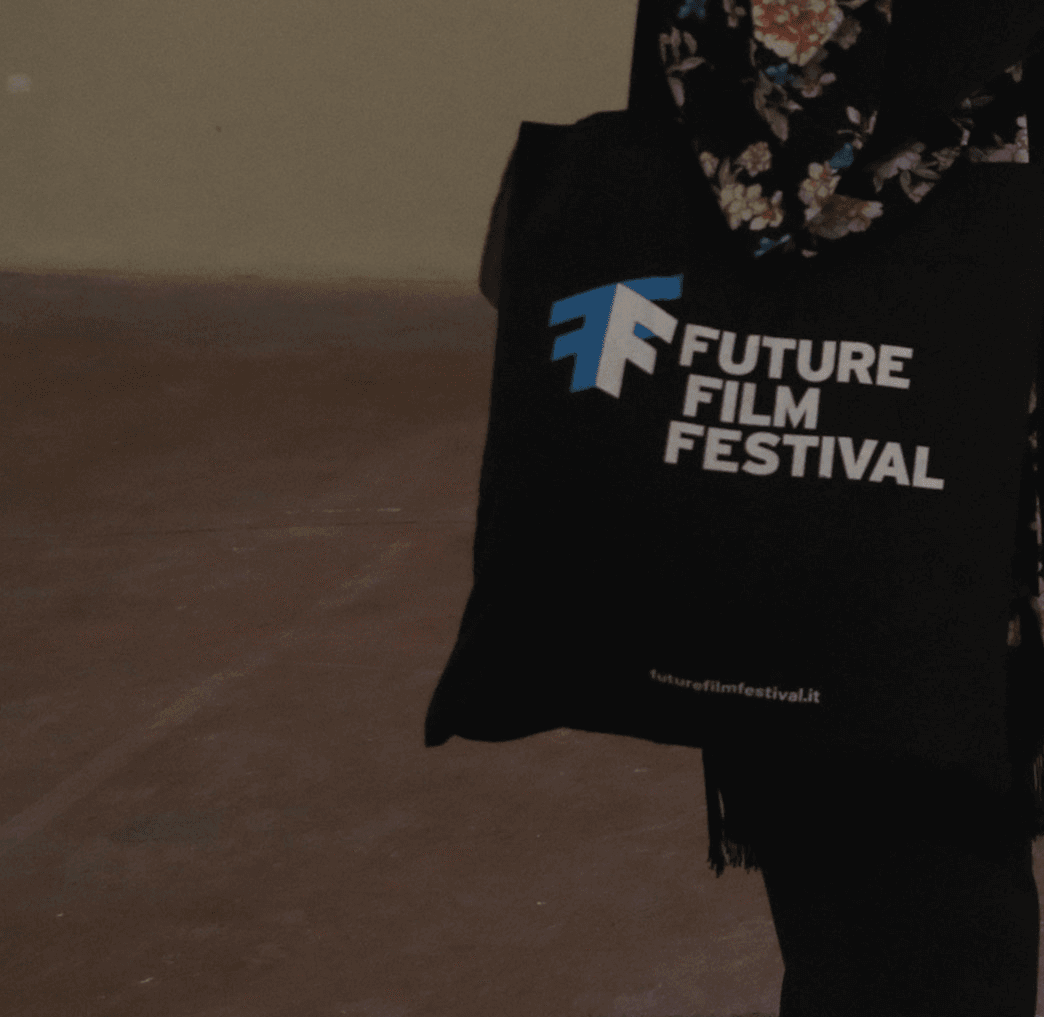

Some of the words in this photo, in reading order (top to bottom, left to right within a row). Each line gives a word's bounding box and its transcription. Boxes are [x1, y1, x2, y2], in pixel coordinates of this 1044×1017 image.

[679, 323, 914, 389] FUTURE
[682, 373, 821, 431] FILM
[664, 420, 945, 490] FESTIVAL
[649, 668, 821, 704] futurefilmfestival.it
